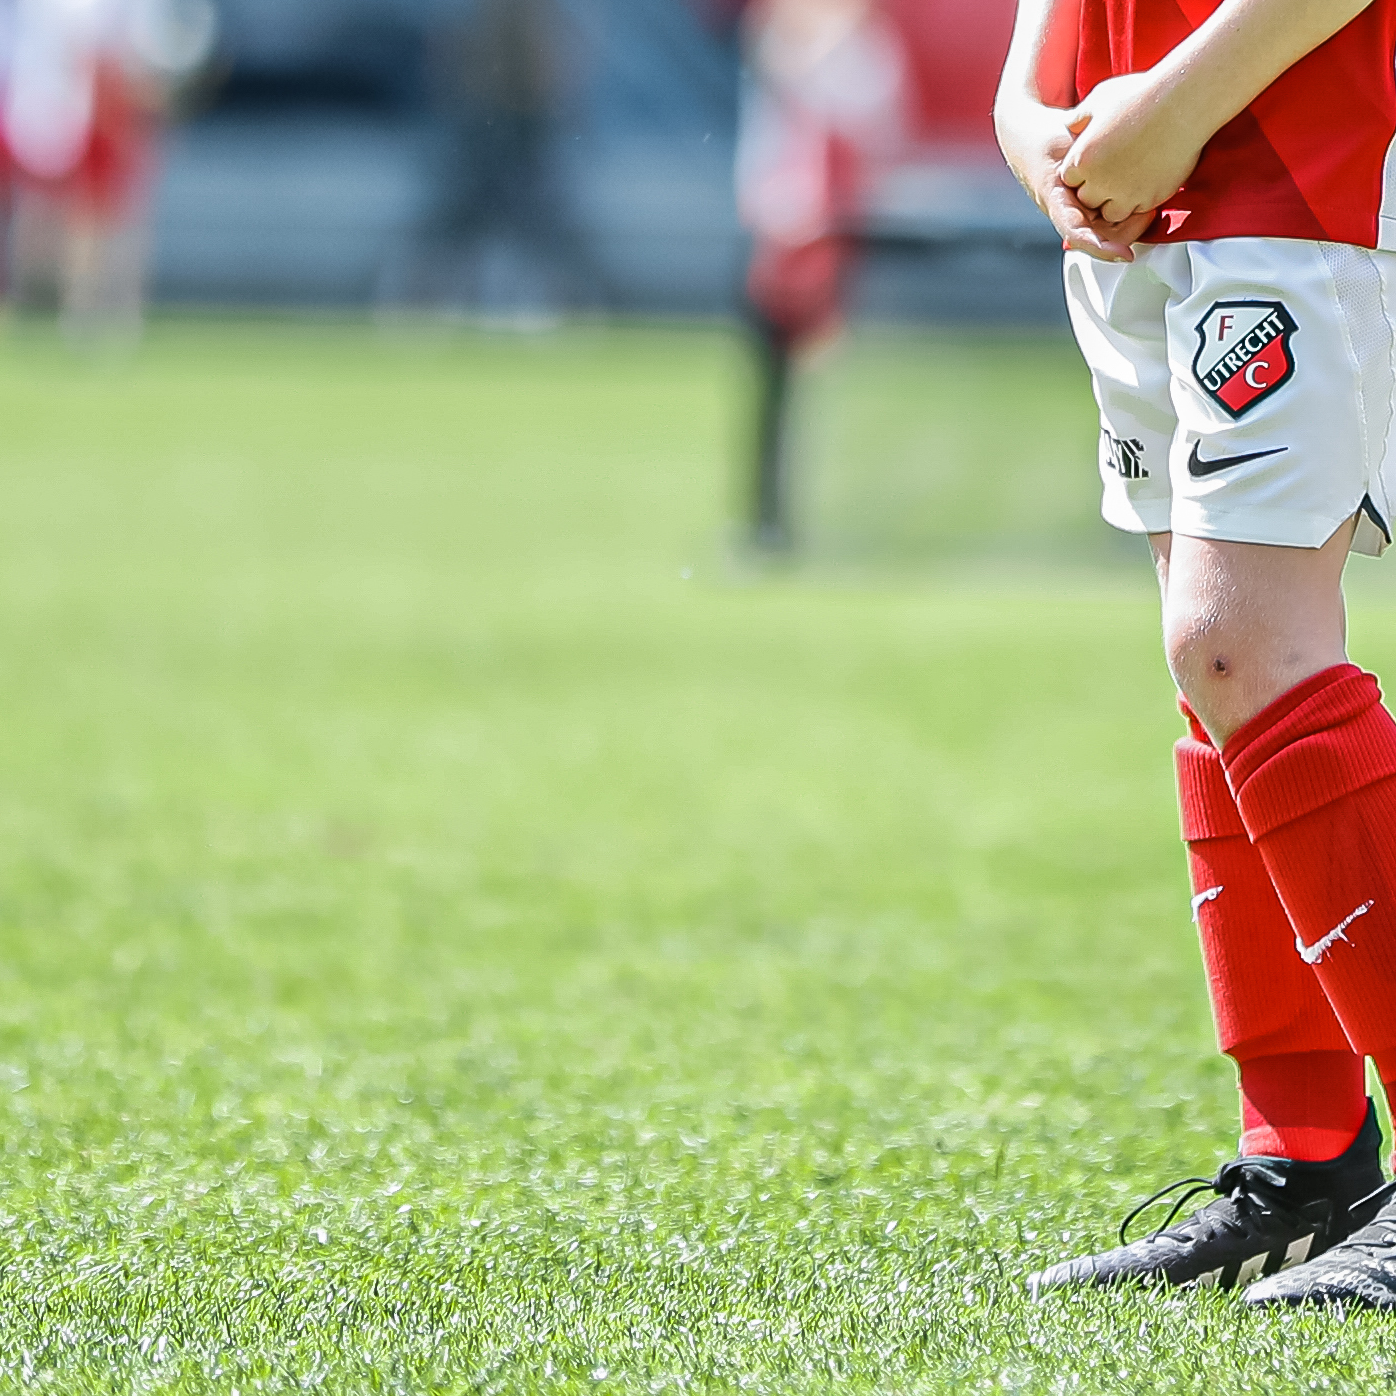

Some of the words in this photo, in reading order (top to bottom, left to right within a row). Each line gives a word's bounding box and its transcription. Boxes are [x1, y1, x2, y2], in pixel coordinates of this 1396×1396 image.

[1218, 315, 1235, 342] F
[1203, 311, 1285, 391] UTRECHT
[1245, 361, 1269, 389] C
